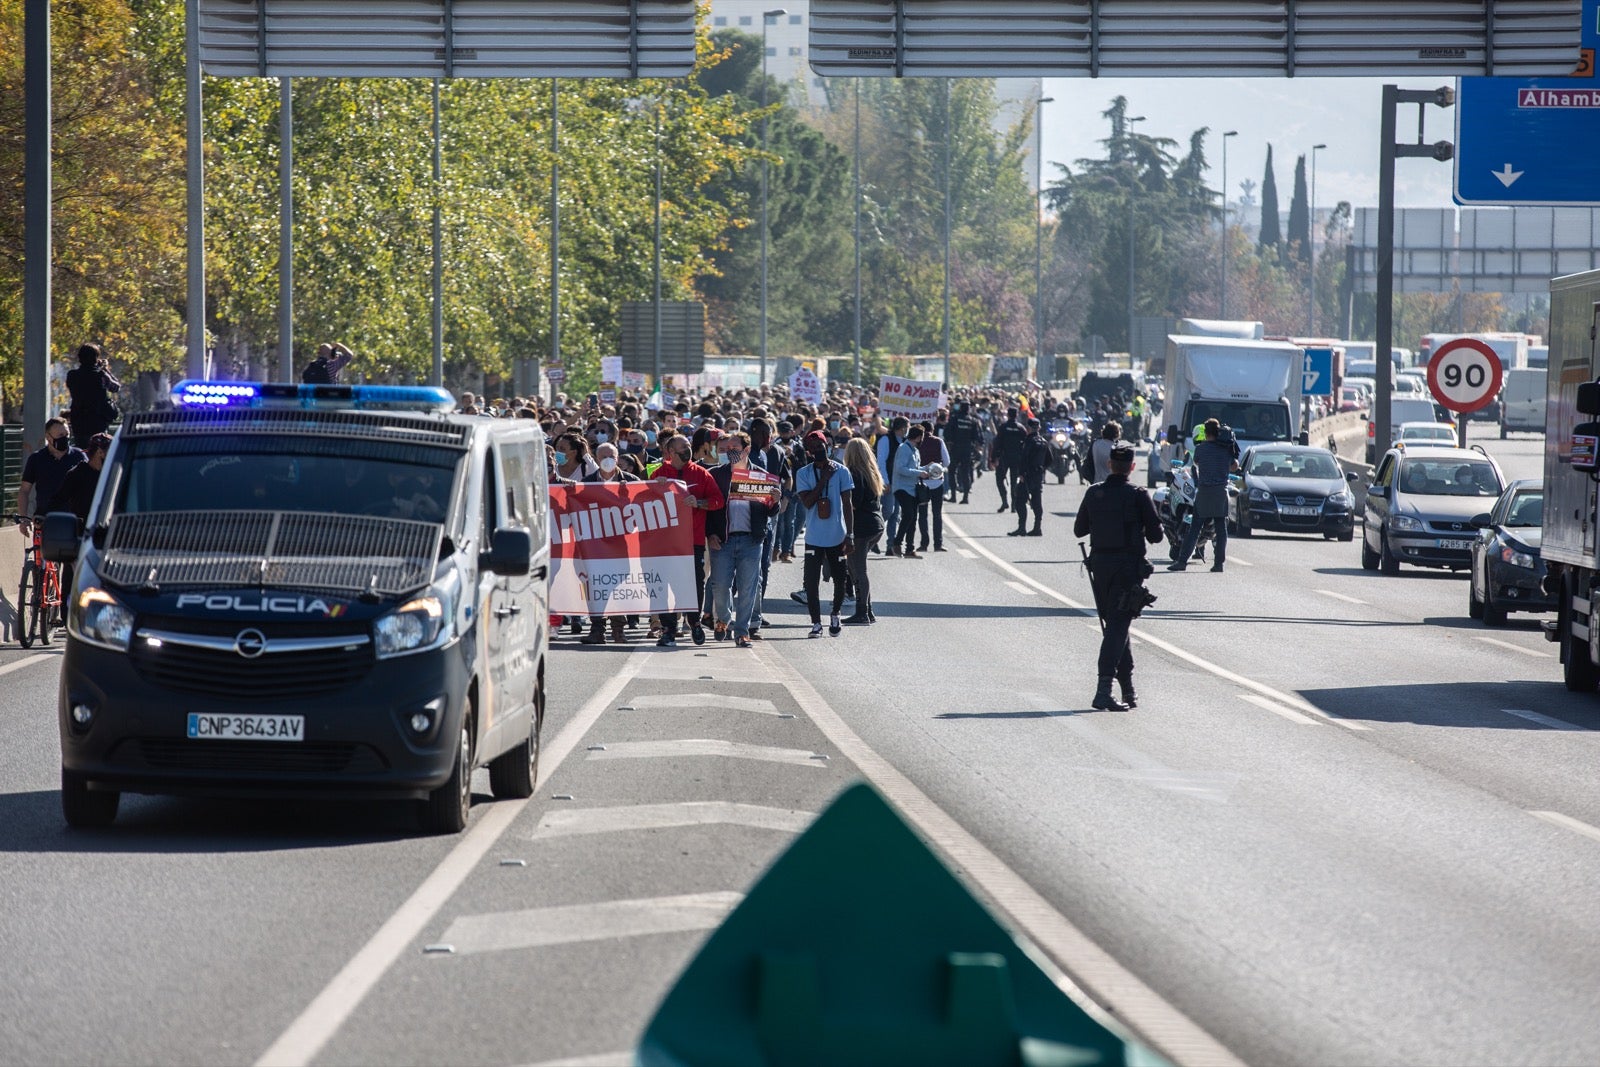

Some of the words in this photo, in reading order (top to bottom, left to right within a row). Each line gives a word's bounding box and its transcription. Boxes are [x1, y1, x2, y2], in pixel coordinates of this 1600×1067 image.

[1444, 363, 1485, 388] 90
[884, 382, 901, 393] NO
[592, 569, 662, 585] HOSTELERÍA
[593, 589, 609, 601] DE
[613, 586, 657, 601] ESPAÑA
